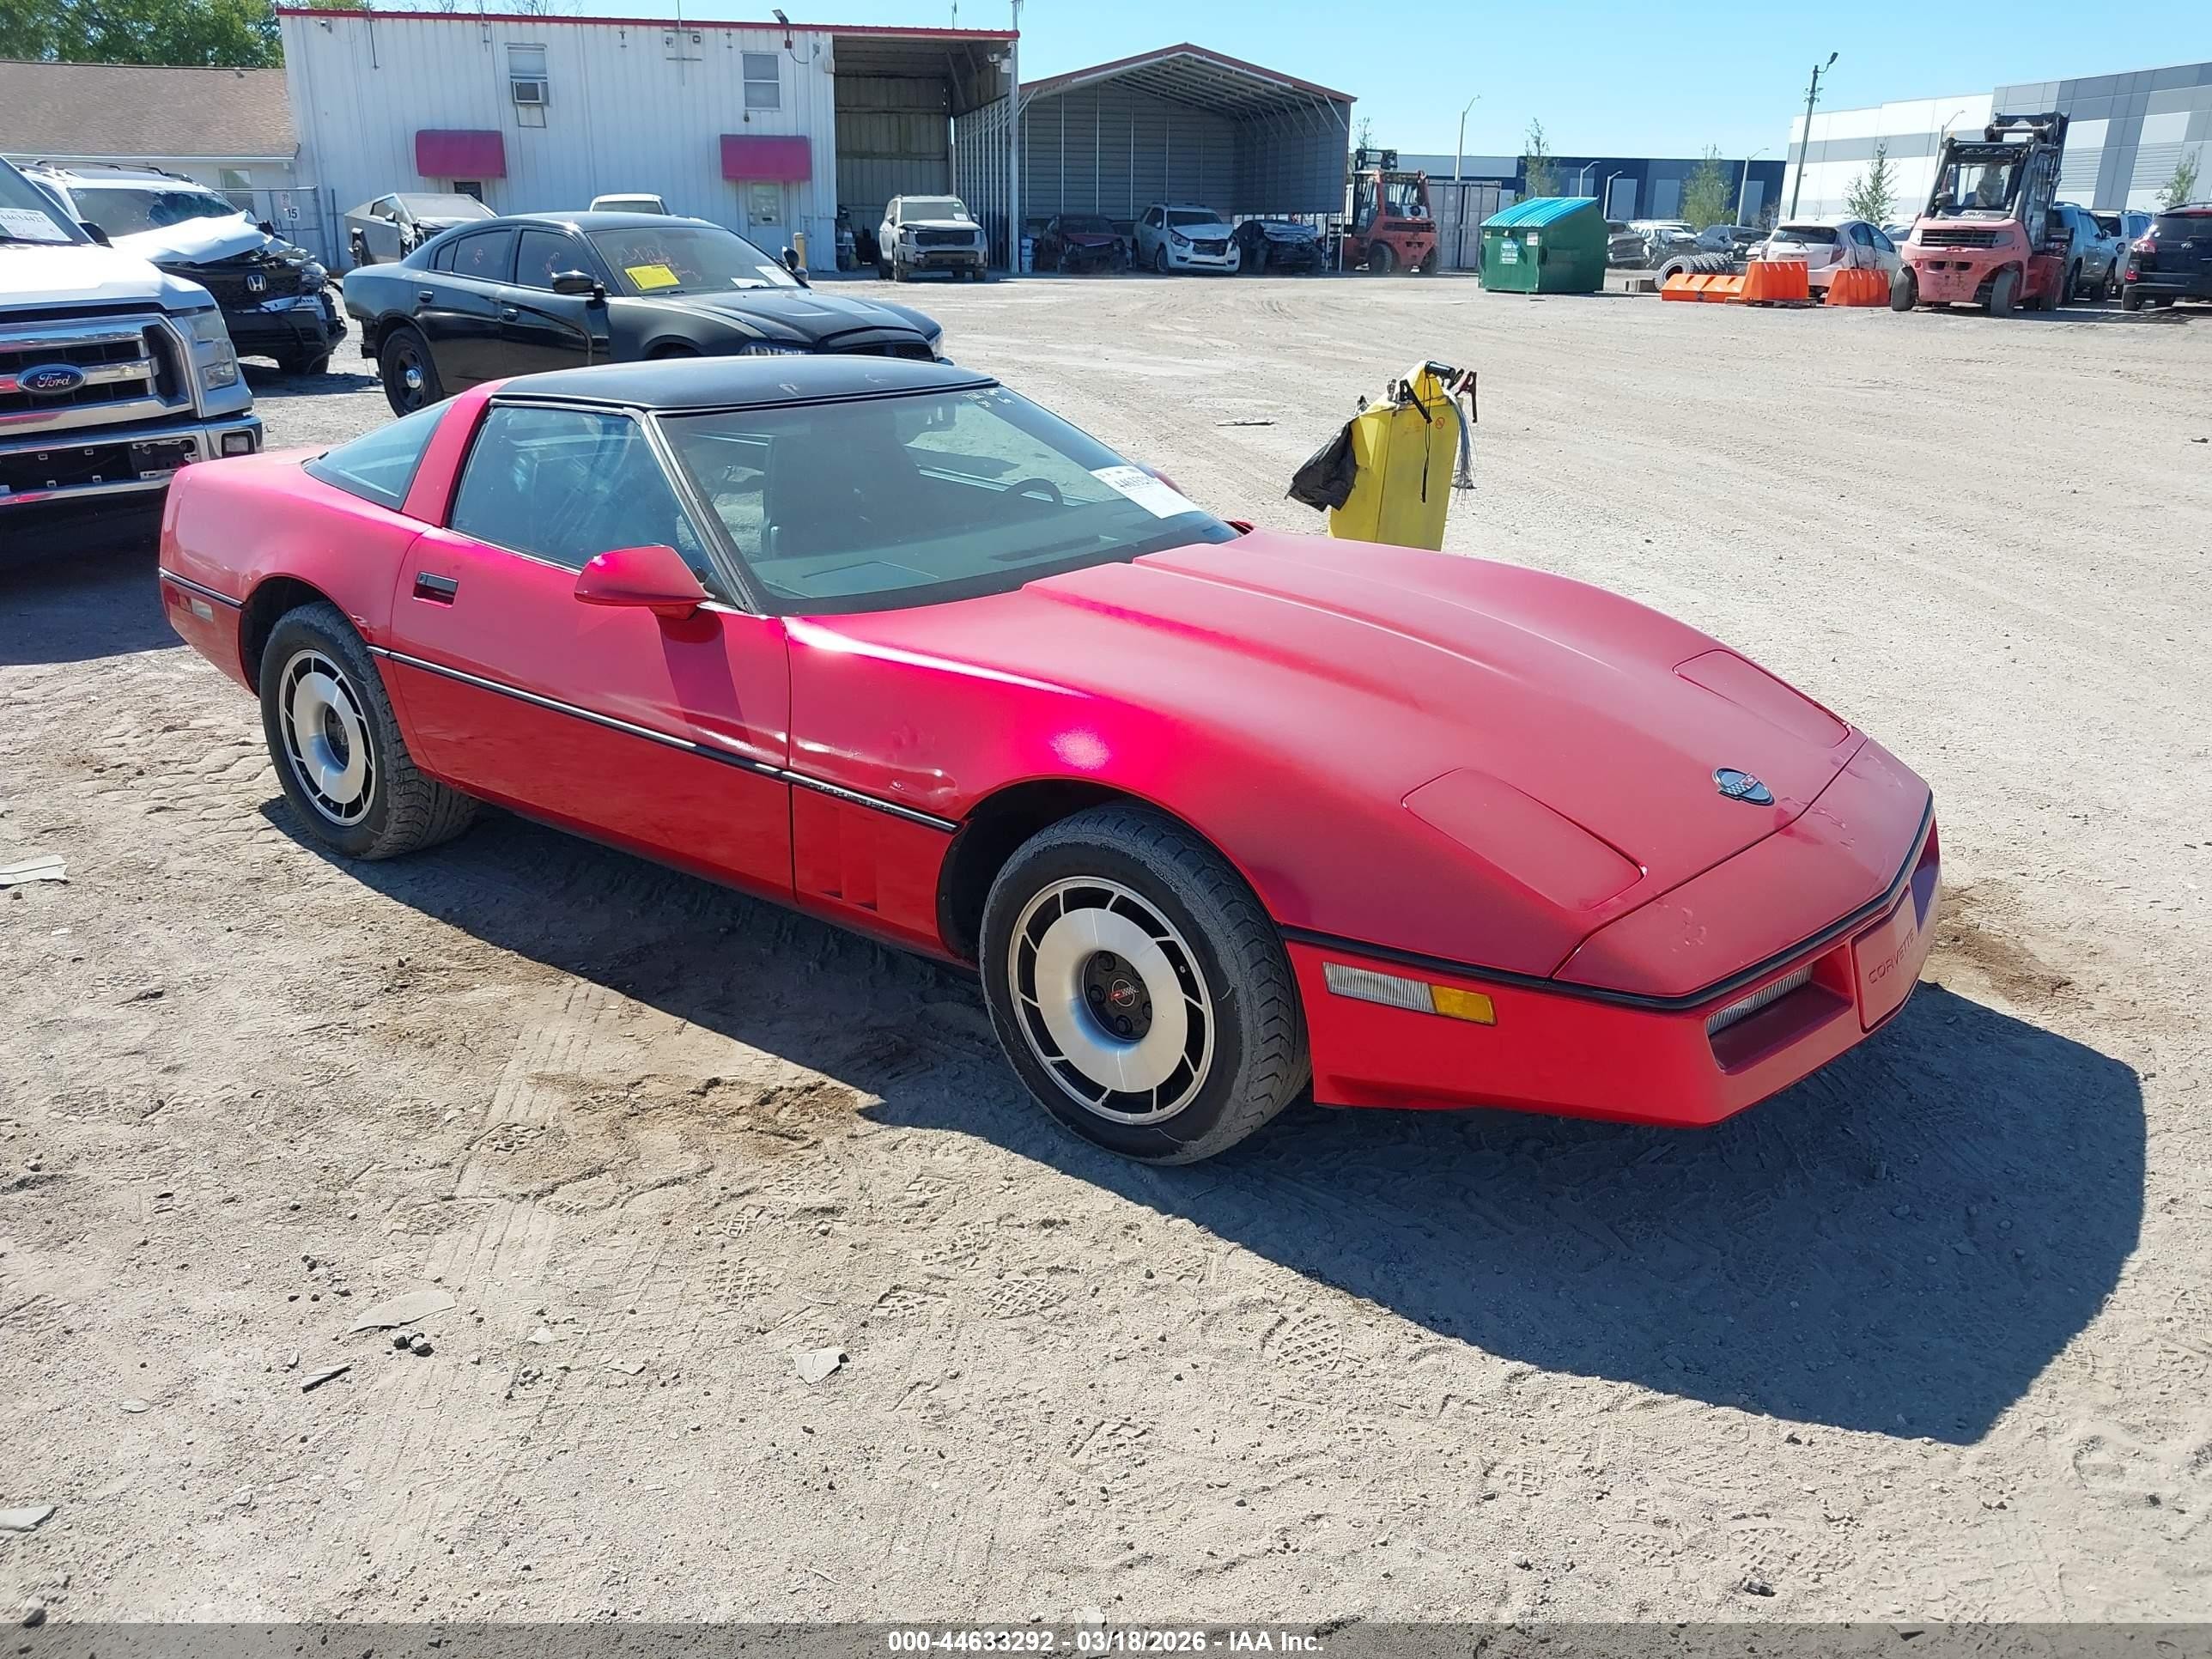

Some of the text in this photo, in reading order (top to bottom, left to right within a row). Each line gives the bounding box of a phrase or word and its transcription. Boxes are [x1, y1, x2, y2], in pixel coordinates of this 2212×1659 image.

[287, 209, 298, 219] 15
[37, 372, 70, 388] Ford
[1868, 927, 1915, 984] CORVETTE
